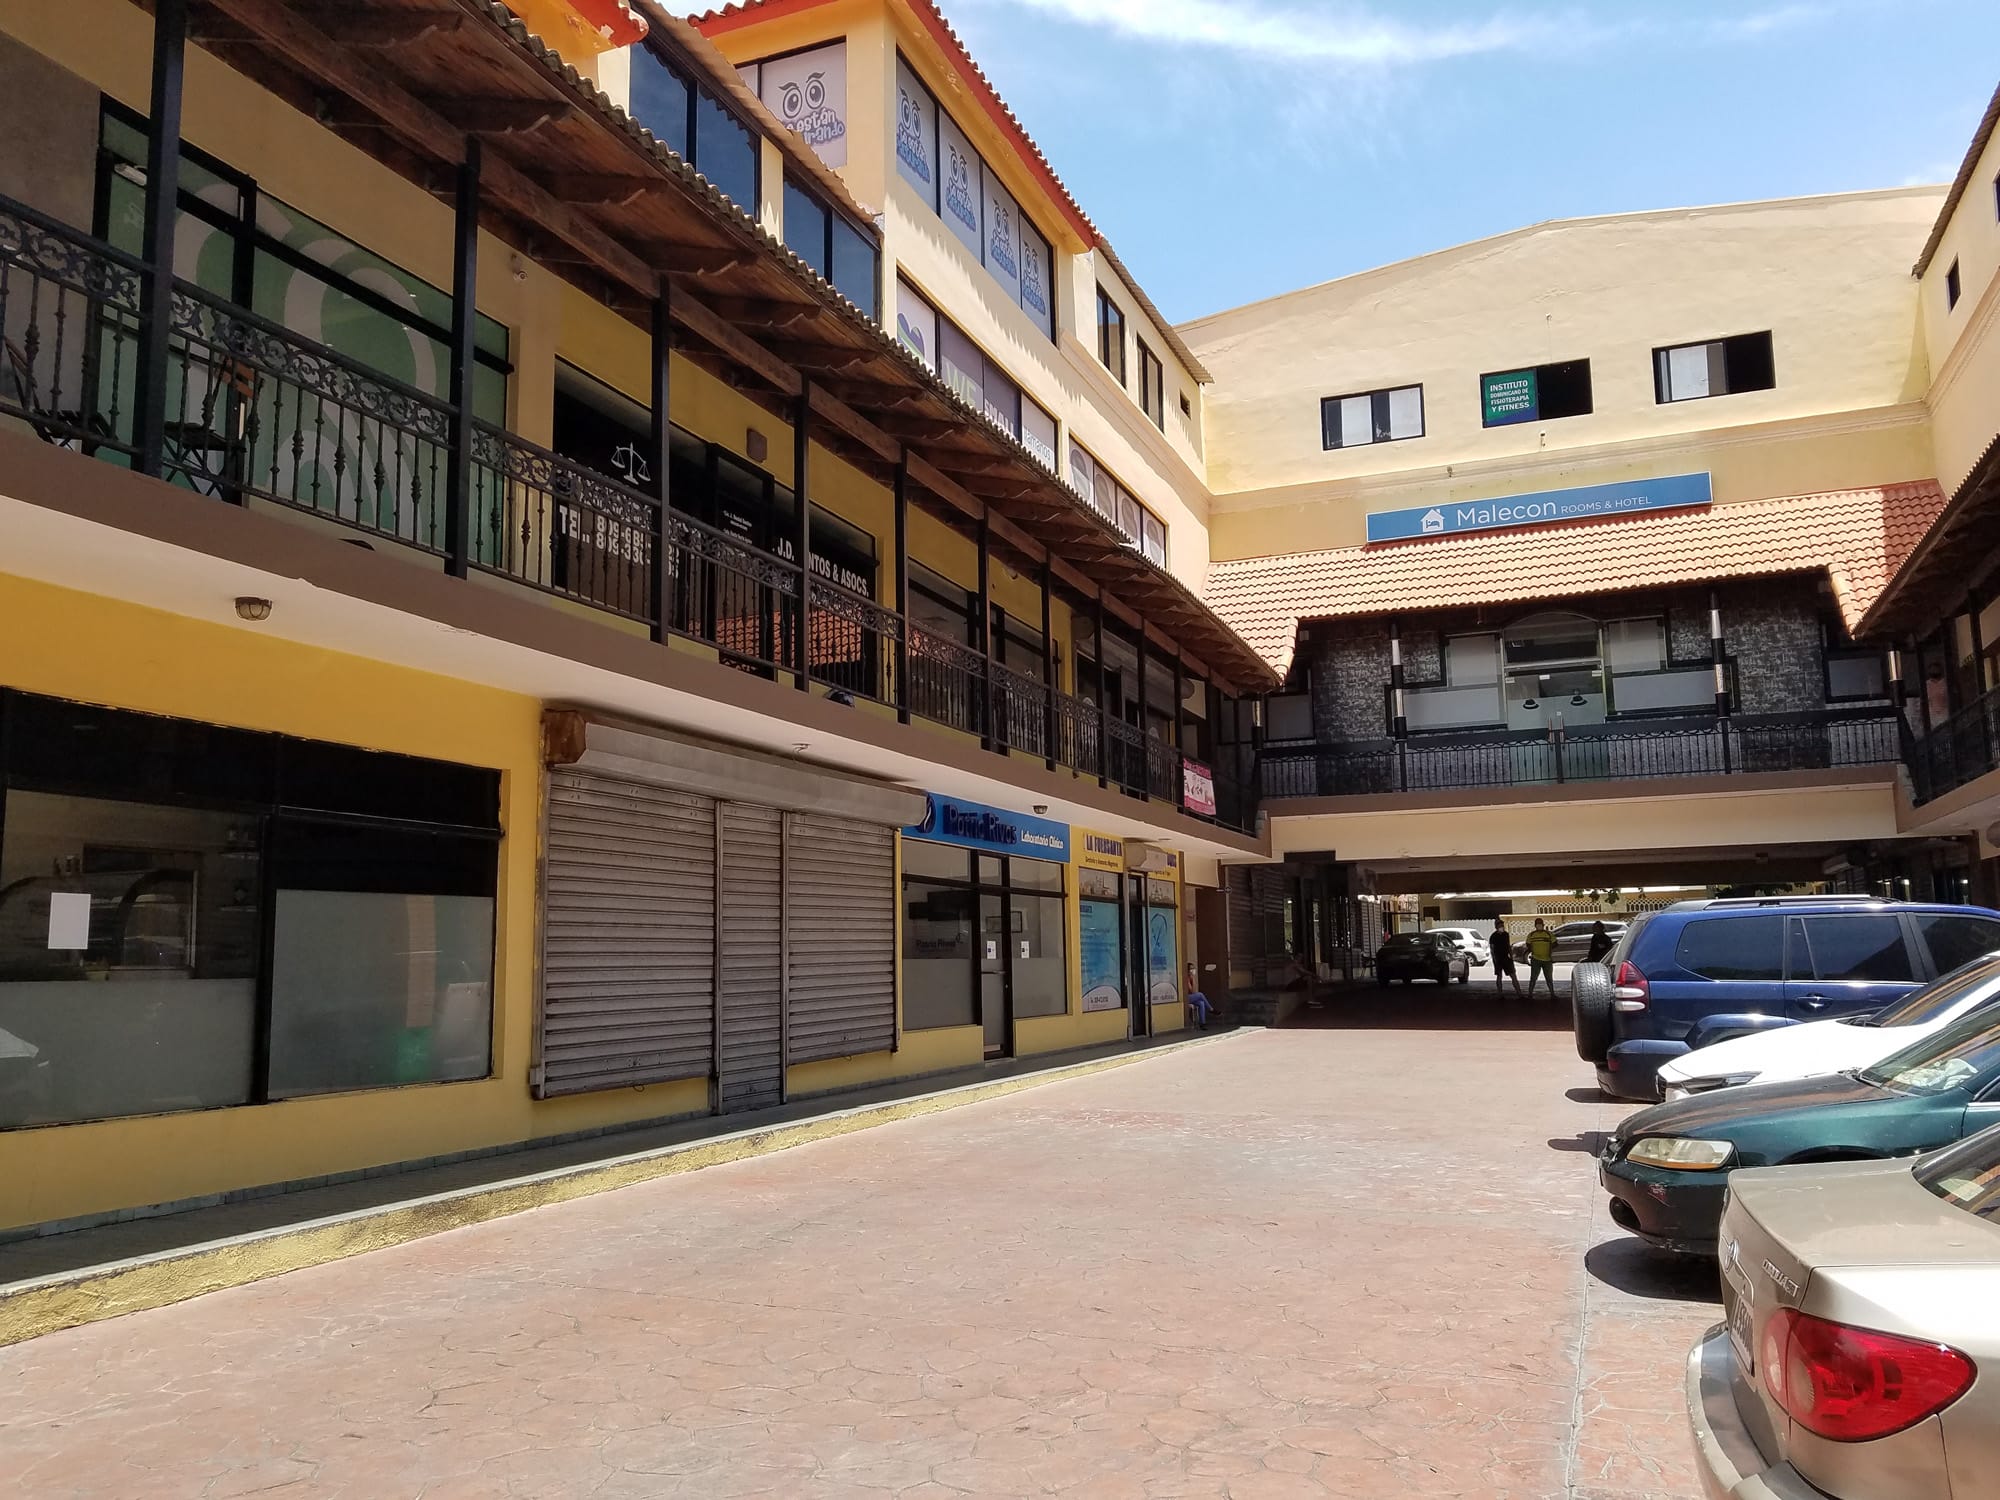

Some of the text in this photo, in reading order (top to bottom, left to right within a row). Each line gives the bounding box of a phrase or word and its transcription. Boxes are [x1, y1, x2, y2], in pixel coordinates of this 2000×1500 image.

[1490, 380, 1528, 392] INSTITUTO
[1490, 389, 1521, 399] DOMINICANO
[1490, 395, 1529, 405] FISIOTERAPIA
[1491, 402, 1530, 413] Y FITNESS
[1457, 496, 1653, 527] Malecon ROOMS & HOTEL
[832, 563, 839, 583] &
[840, 568, 869, 598] ASOCS.
